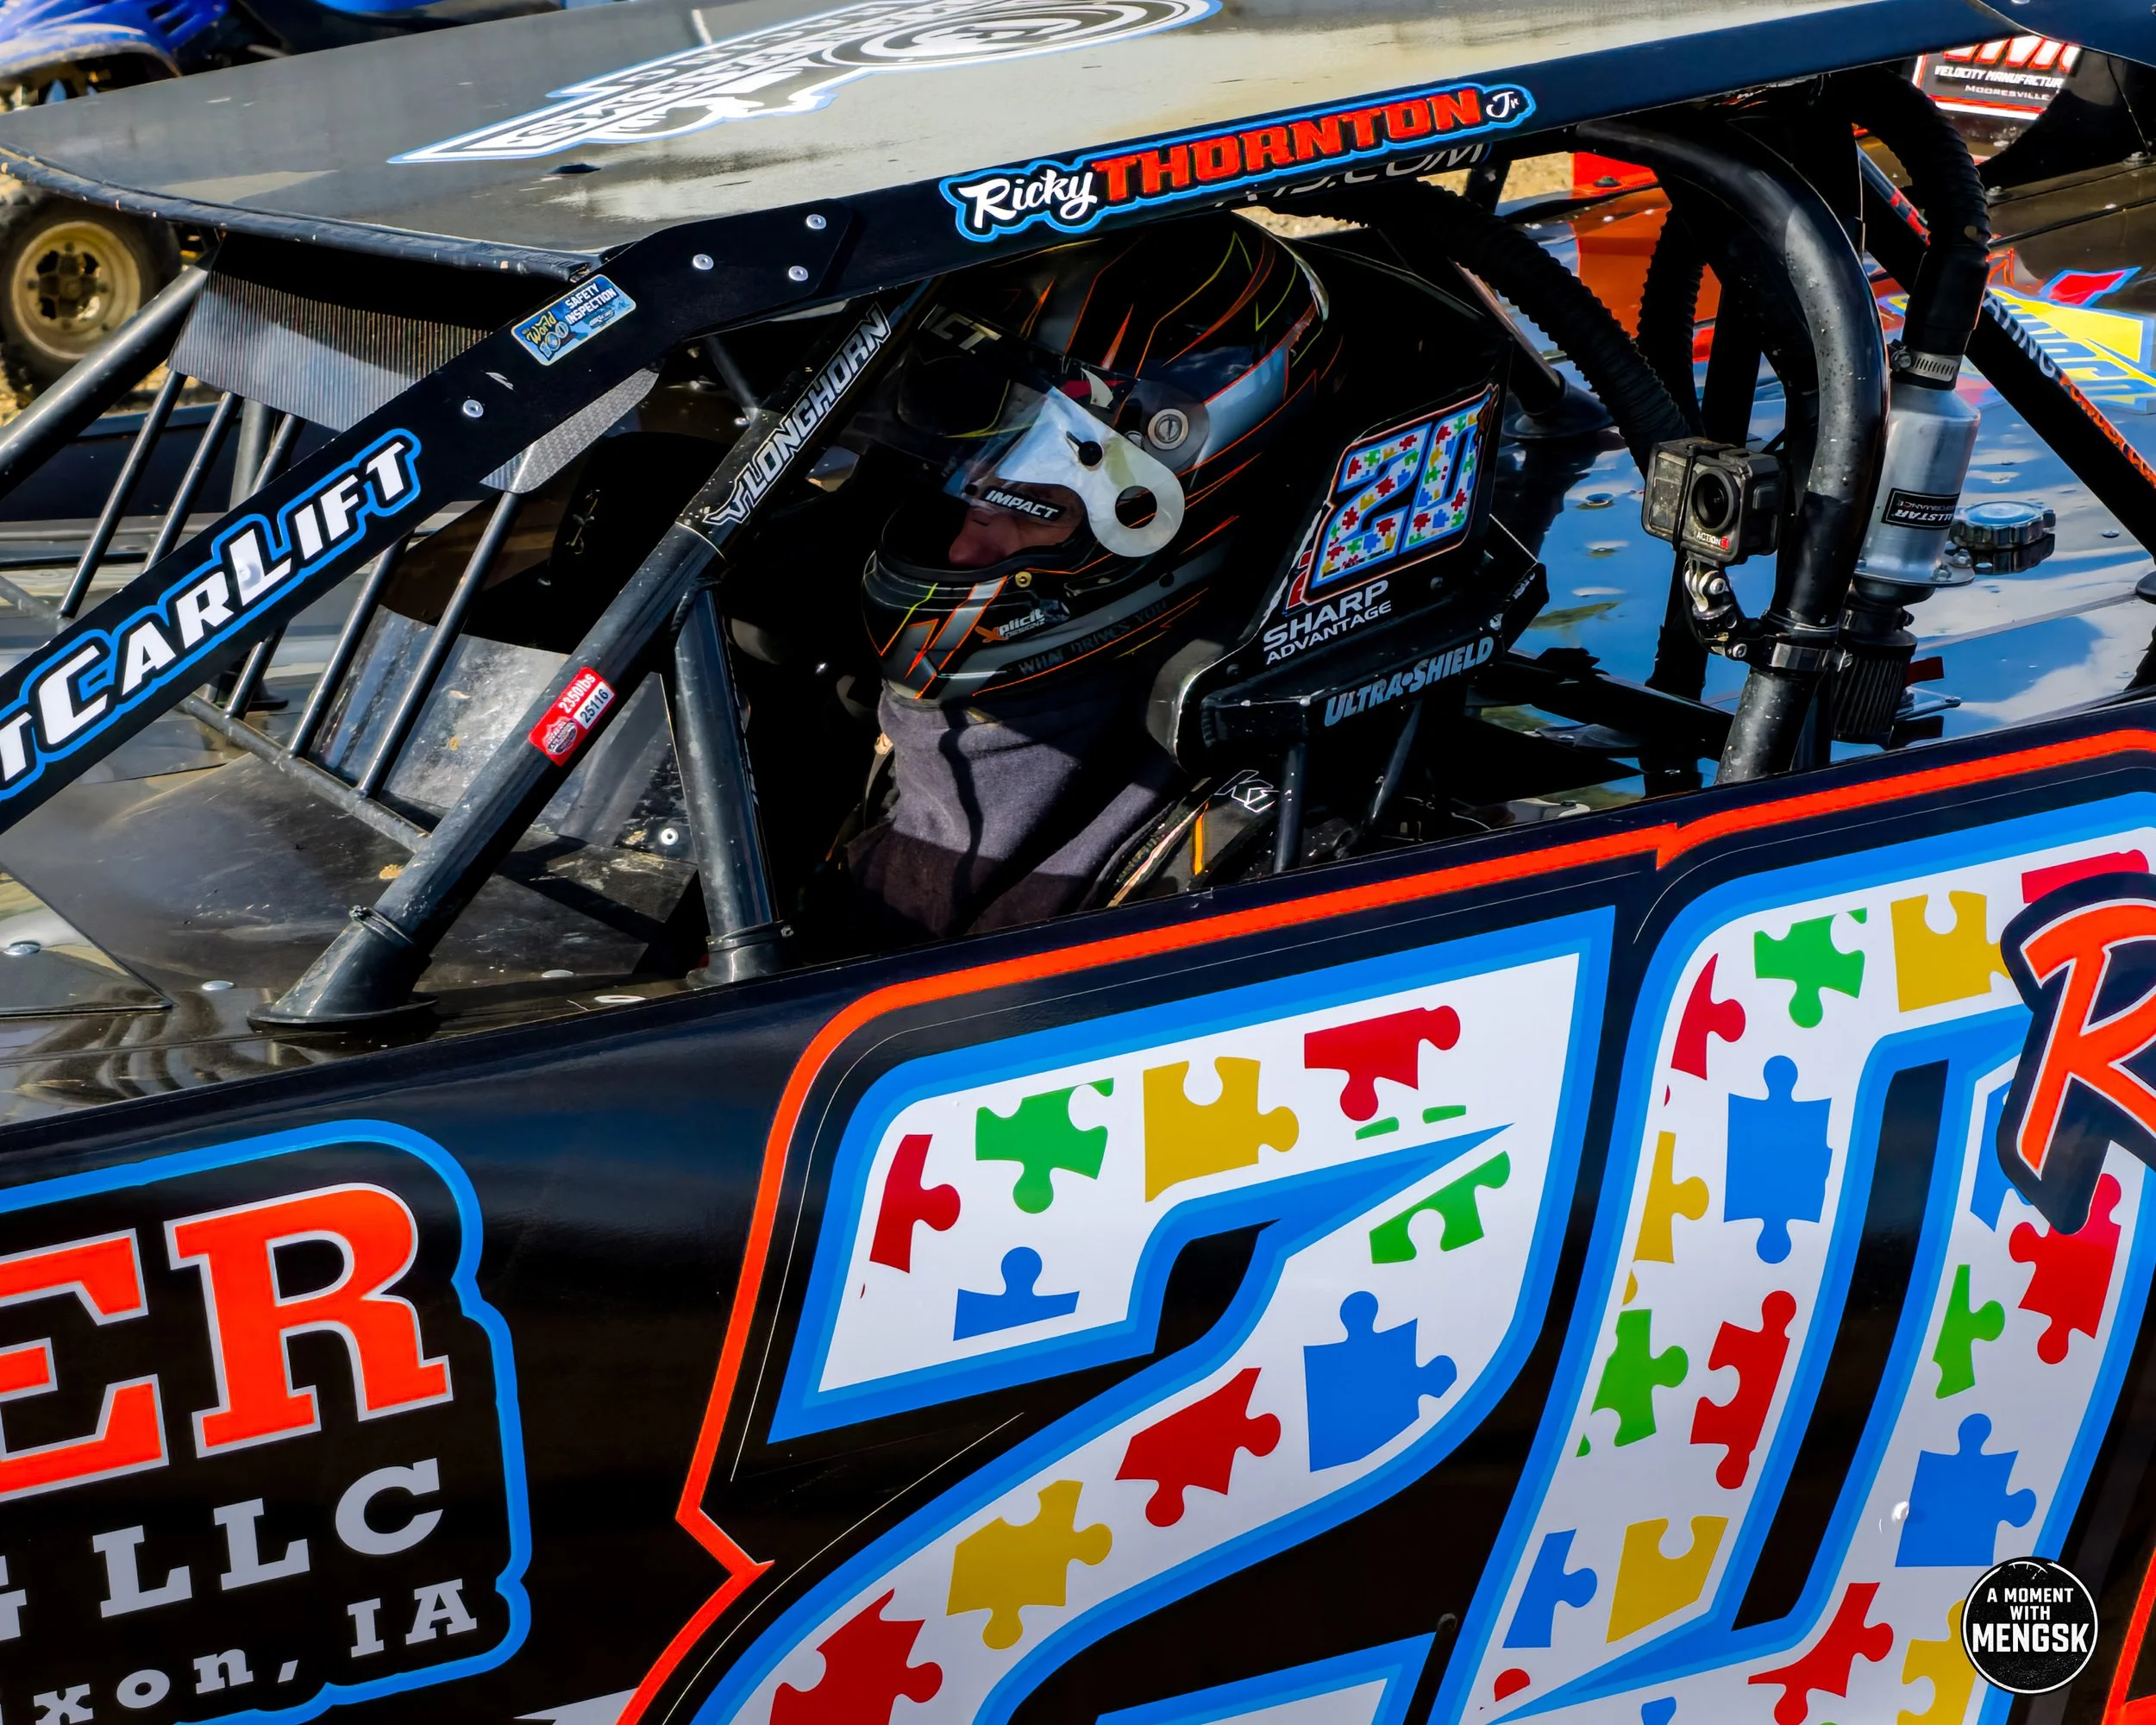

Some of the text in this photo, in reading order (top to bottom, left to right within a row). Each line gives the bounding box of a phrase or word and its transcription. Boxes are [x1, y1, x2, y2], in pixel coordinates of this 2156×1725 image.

[1934, 65, 1986, 80] VELOCITY
[1965, 85, 2051, 101] MOORESVILLE
[958, 169, 1098, 229] Ricky
[1091, 89, 1482, 204] THORNTON
[565, 283, 600, 310] SAFETY
[565, 288, 617, 325] INSPECTION
[527, 311, 557, 344] World
[743, 307, 889, 501] LONGHORN
[985, 490, 1059, 519] IMPACT
[1310, 394, 1494, 590] 20
[1695, 530, 1721, 546] ACTION
[1263, 580, 1389, 653] SHARP
[1265, 600, 1393, 666] ADVANTAGE
[559, 674, 597, 714] 2350lbs
[580, 688, 609, 724] 25116
[92, 1458, 444, 1618] LLC
[347, 1578, 478, 1659] IA
